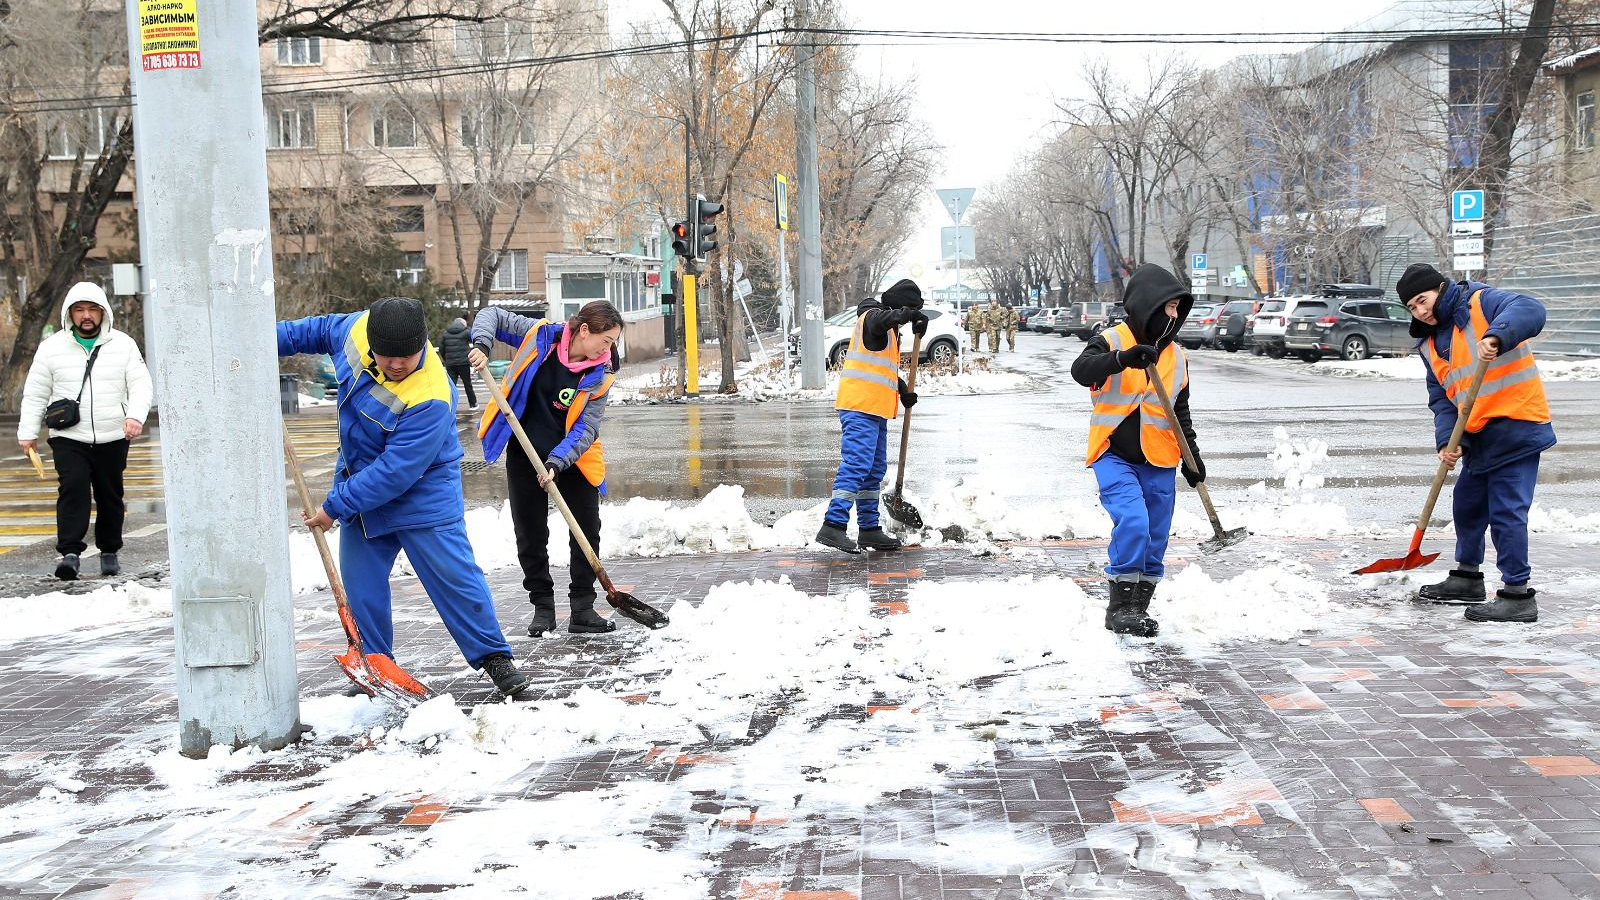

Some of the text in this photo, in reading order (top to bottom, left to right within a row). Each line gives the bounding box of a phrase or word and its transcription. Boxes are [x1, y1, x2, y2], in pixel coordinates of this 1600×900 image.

[147, 3, 183, 11] АЛКО-НАРКО
[141, 13, 195, 26] ЗАВИСИМЫМ
[162, 54, 177, 68] 636
[178, 54, 187, 67] 73
[188, 53, 198, 67] 73
[1459, 194, 1476, 218] P
[1195, 256, 1204, 268] P
